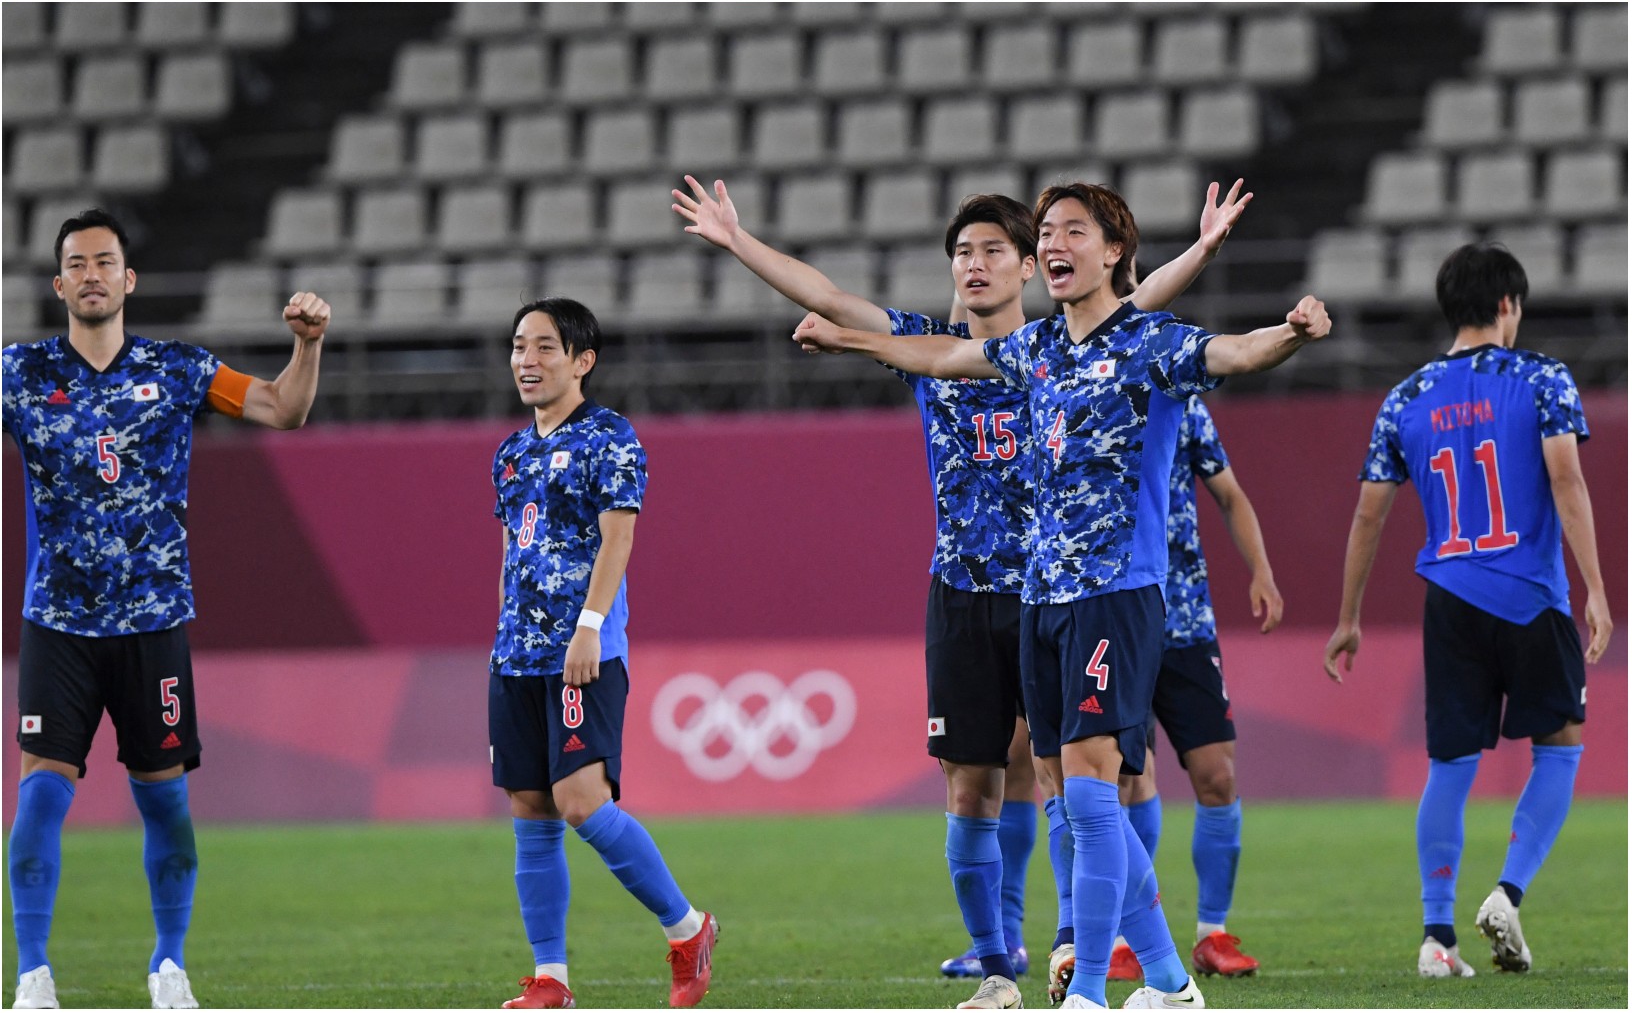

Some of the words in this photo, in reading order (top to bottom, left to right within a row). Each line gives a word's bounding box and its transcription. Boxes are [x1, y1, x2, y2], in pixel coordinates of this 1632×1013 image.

[972, 412, 1017, 460] 15
[1046, 410, 1065, 461] 4
[1430, 398, 1495, 434] MITOMA
[96, 434, 120, 484] 5
[1429, 439, 1519, 559] 11
[517, 502, 538, 549] 8
[1085, 638, 1110, 691] 4
[160, 676, 181, 726] 5
[561, 684, 584, 729] 8
